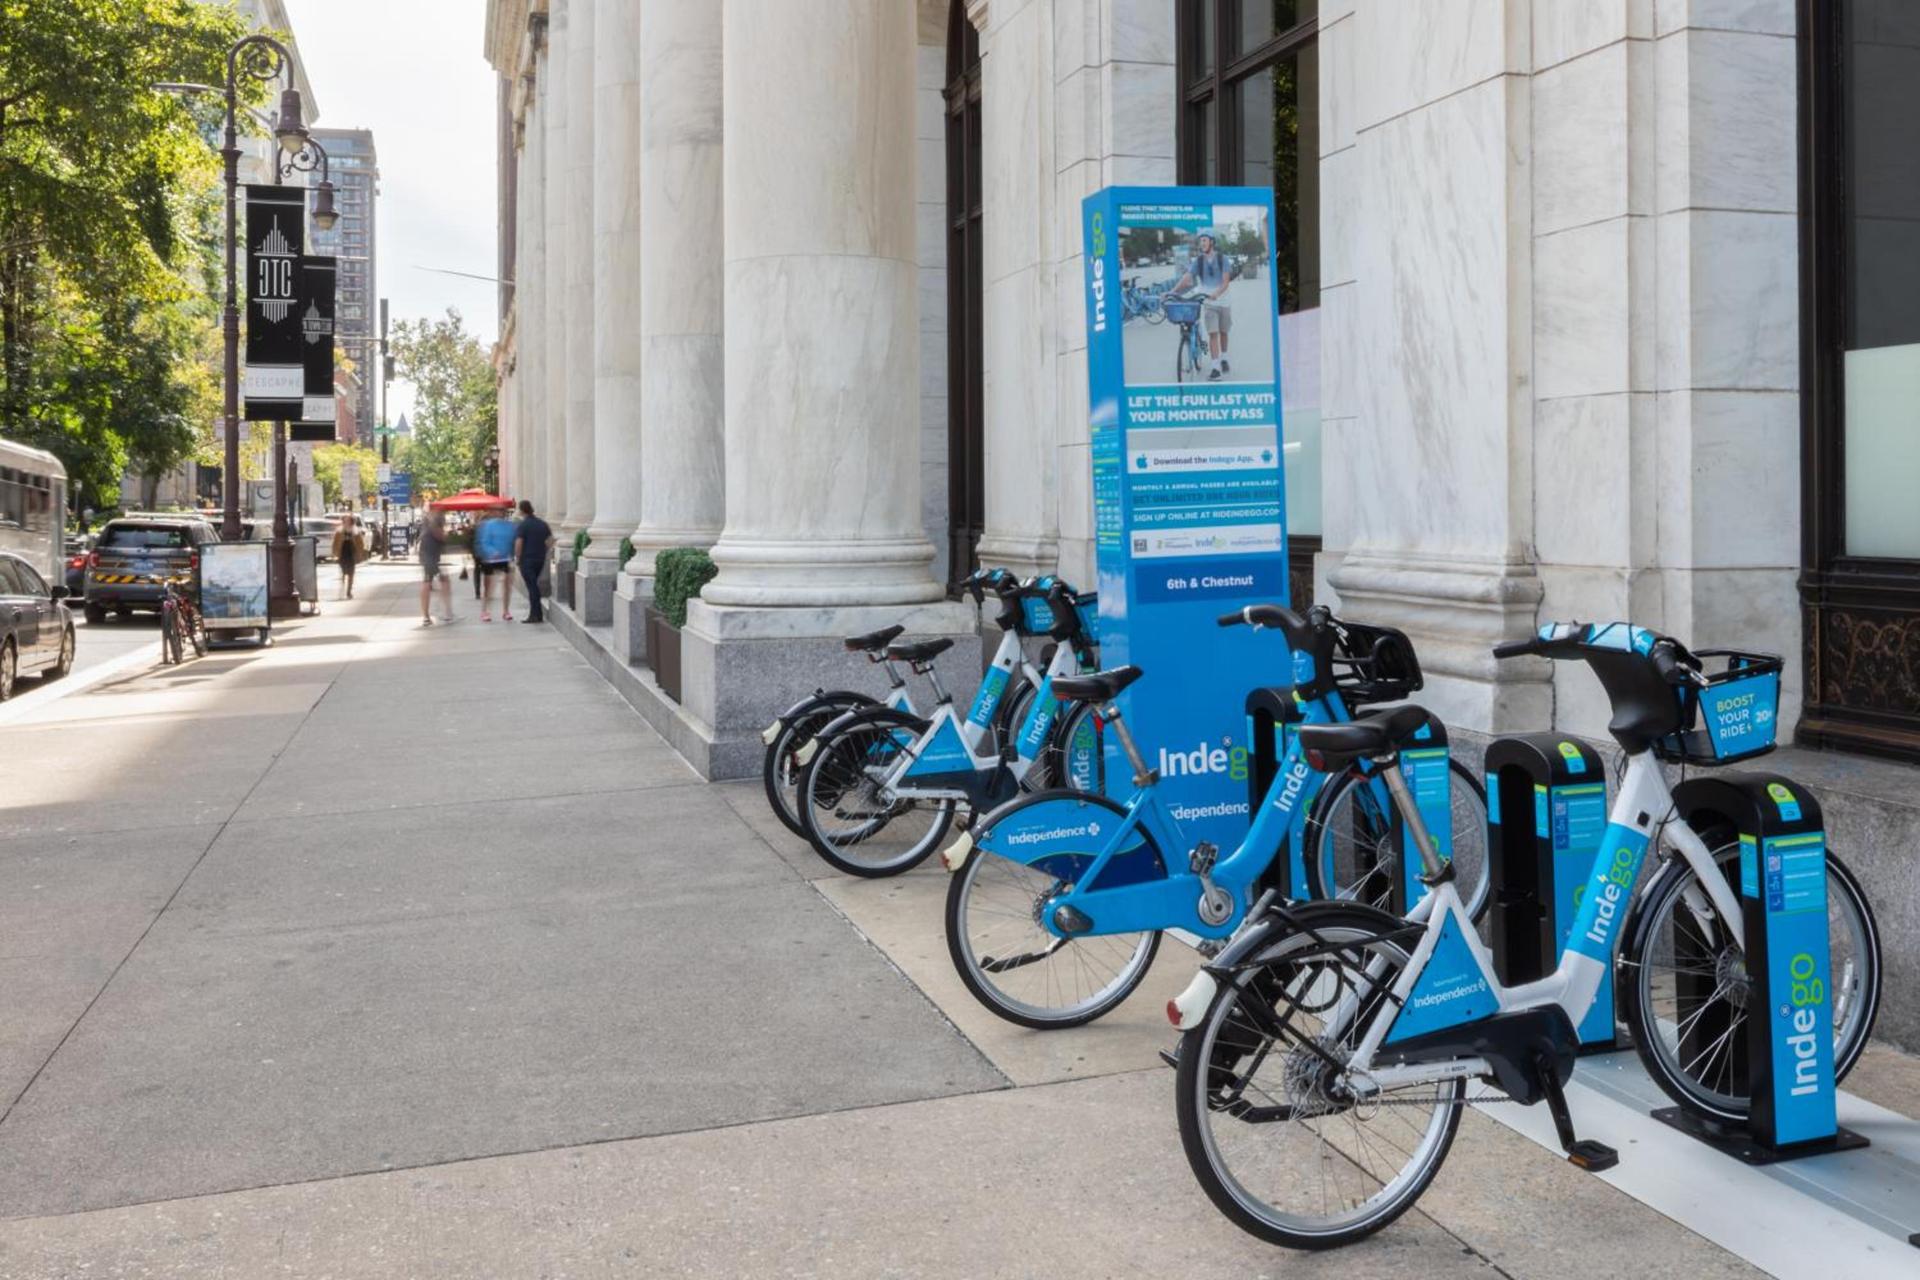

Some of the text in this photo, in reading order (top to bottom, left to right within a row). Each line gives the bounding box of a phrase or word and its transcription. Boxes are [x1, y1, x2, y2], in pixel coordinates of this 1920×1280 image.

[1092, 211, 1106, 331] Indego
[1128, 396, 1152, 408] LET
[1153, 395, 1181, 407] THE
[1182, 394, 1208, 406] FUN
[1211, 394, 1241, 406] LAST
[1129, 408, 1264, 422] YOUR MONTHLY PASS
[1153, 456, 1192, 465] Download
[1194, 456, 1207, 464] the
[1209, 456, 1235, 465] Indego
[1134, 514, 1152, 522] SIGN
[1154, 513, 1166, 521] UP
[1168, 511, 1198, 520] ONLINE
[1167, 575, 1254, 590] 6th & Chestnut
[976, 678, 1002, 722] Indego
[1716, 692, 1755, 712] BOOST
[1026, 699, 1057, 744] Indeg
[1718, 708, 1749, 725] YOUR
[1720, 723, 1746, 740] RIDE
[1159, 742, 1248, 780] Indeg
[1273, 752, 1311, 812] Inde
[1170, 801, 1249, 820] dependenc
[1008, 826, 1086, 845] Independence
[1585, 847, 1633, 944] Indego
[1413, 984, 1478, 1008] Independence
[1788, 953, 1823, 1096] Indego
